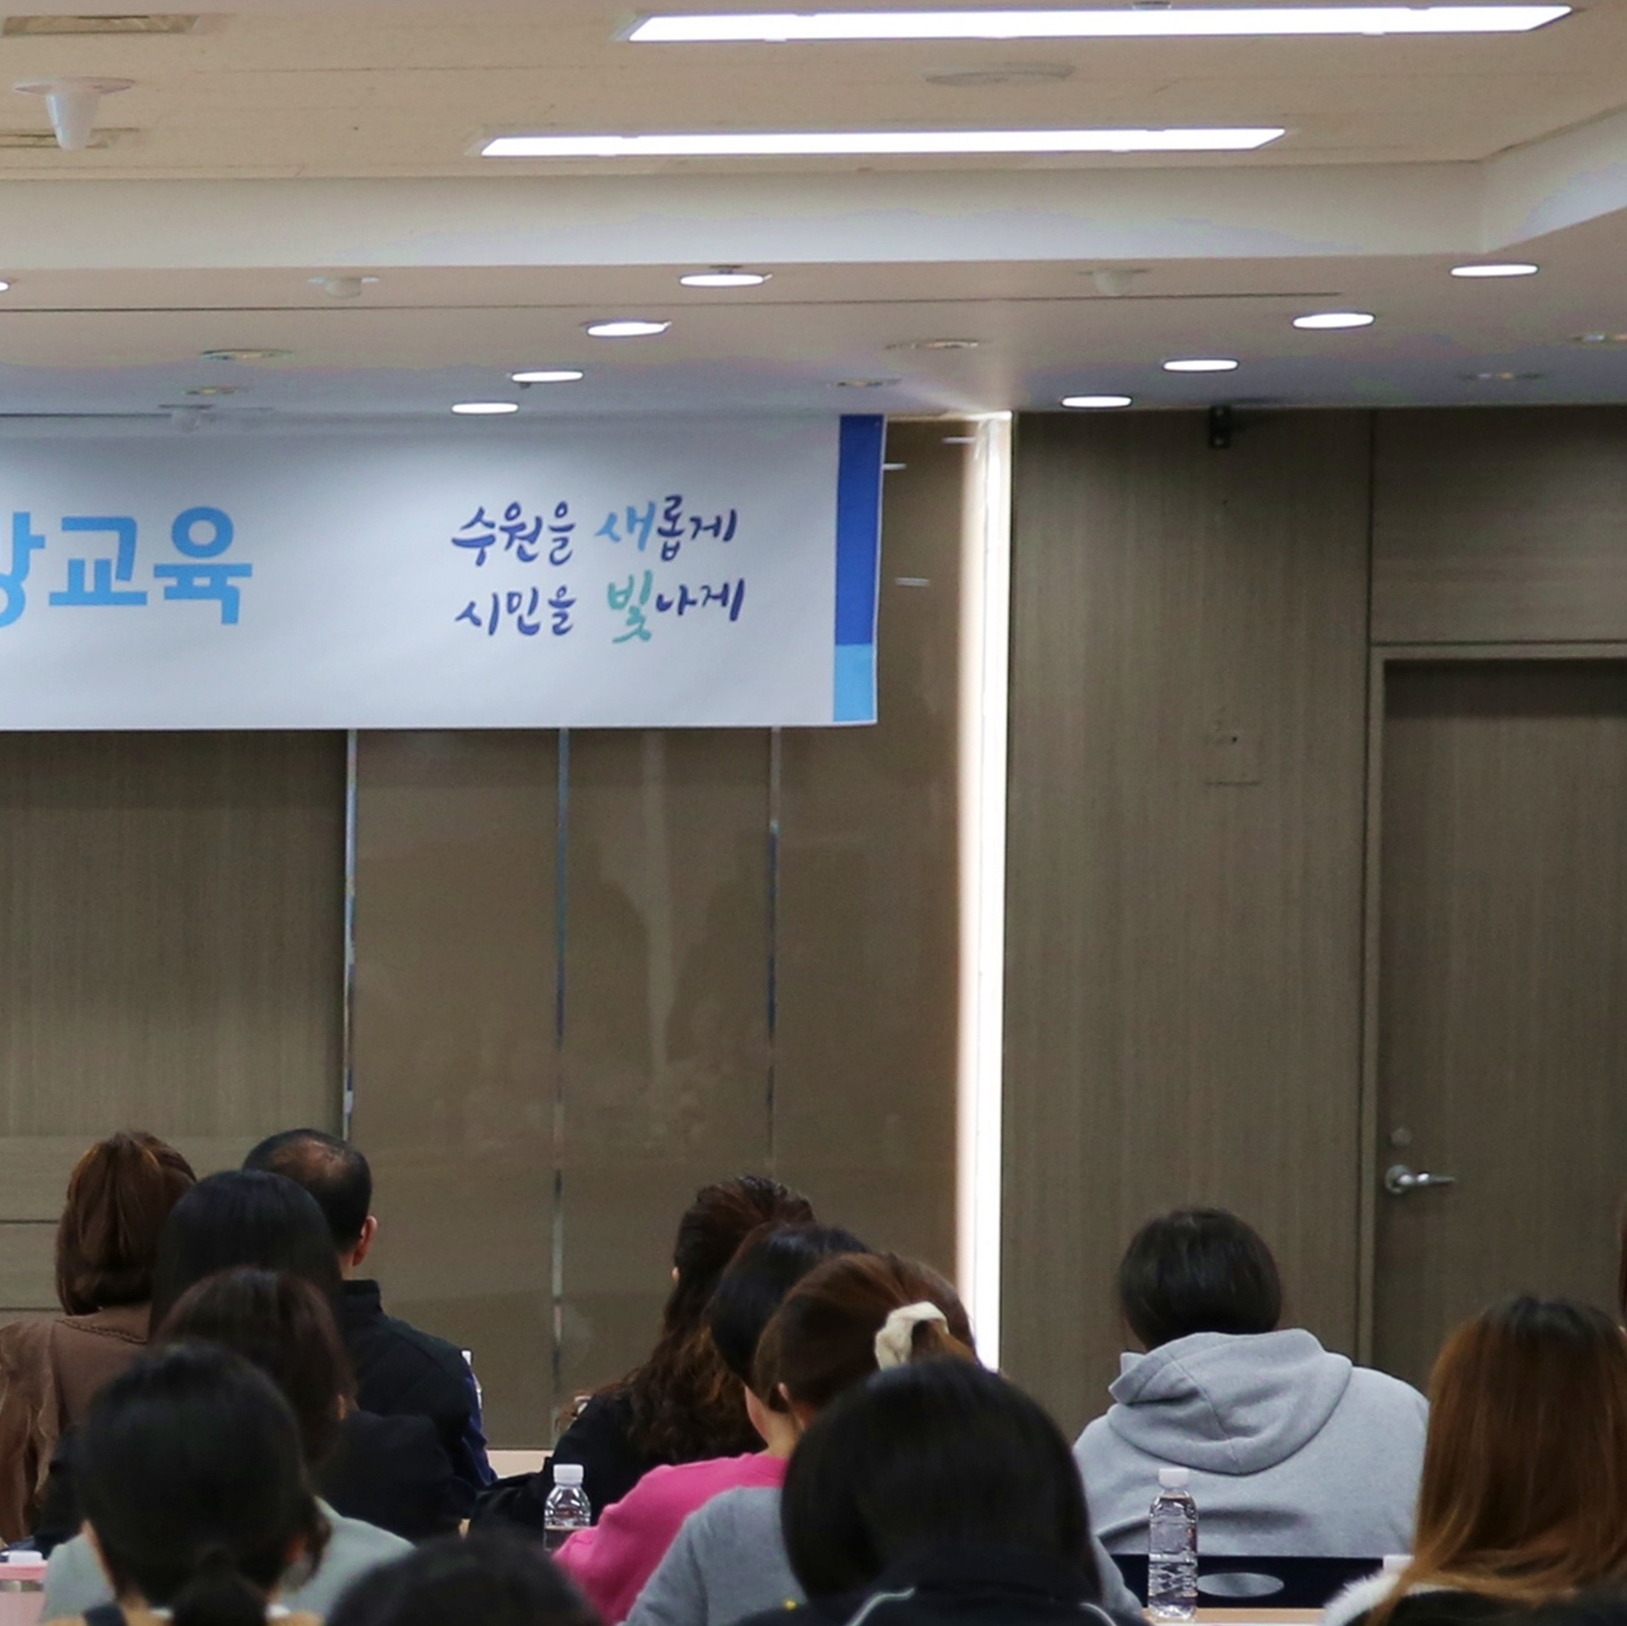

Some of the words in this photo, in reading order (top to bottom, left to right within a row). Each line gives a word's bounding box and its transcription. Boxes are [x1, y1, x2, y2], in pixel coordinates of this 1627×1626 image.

[451, 500, 576, 567] 수원을
[596, 494, 738, 562] 새롭게
[455, 584, 577, 636] 시민을
[606, 569, 746, 643] 빛나게
